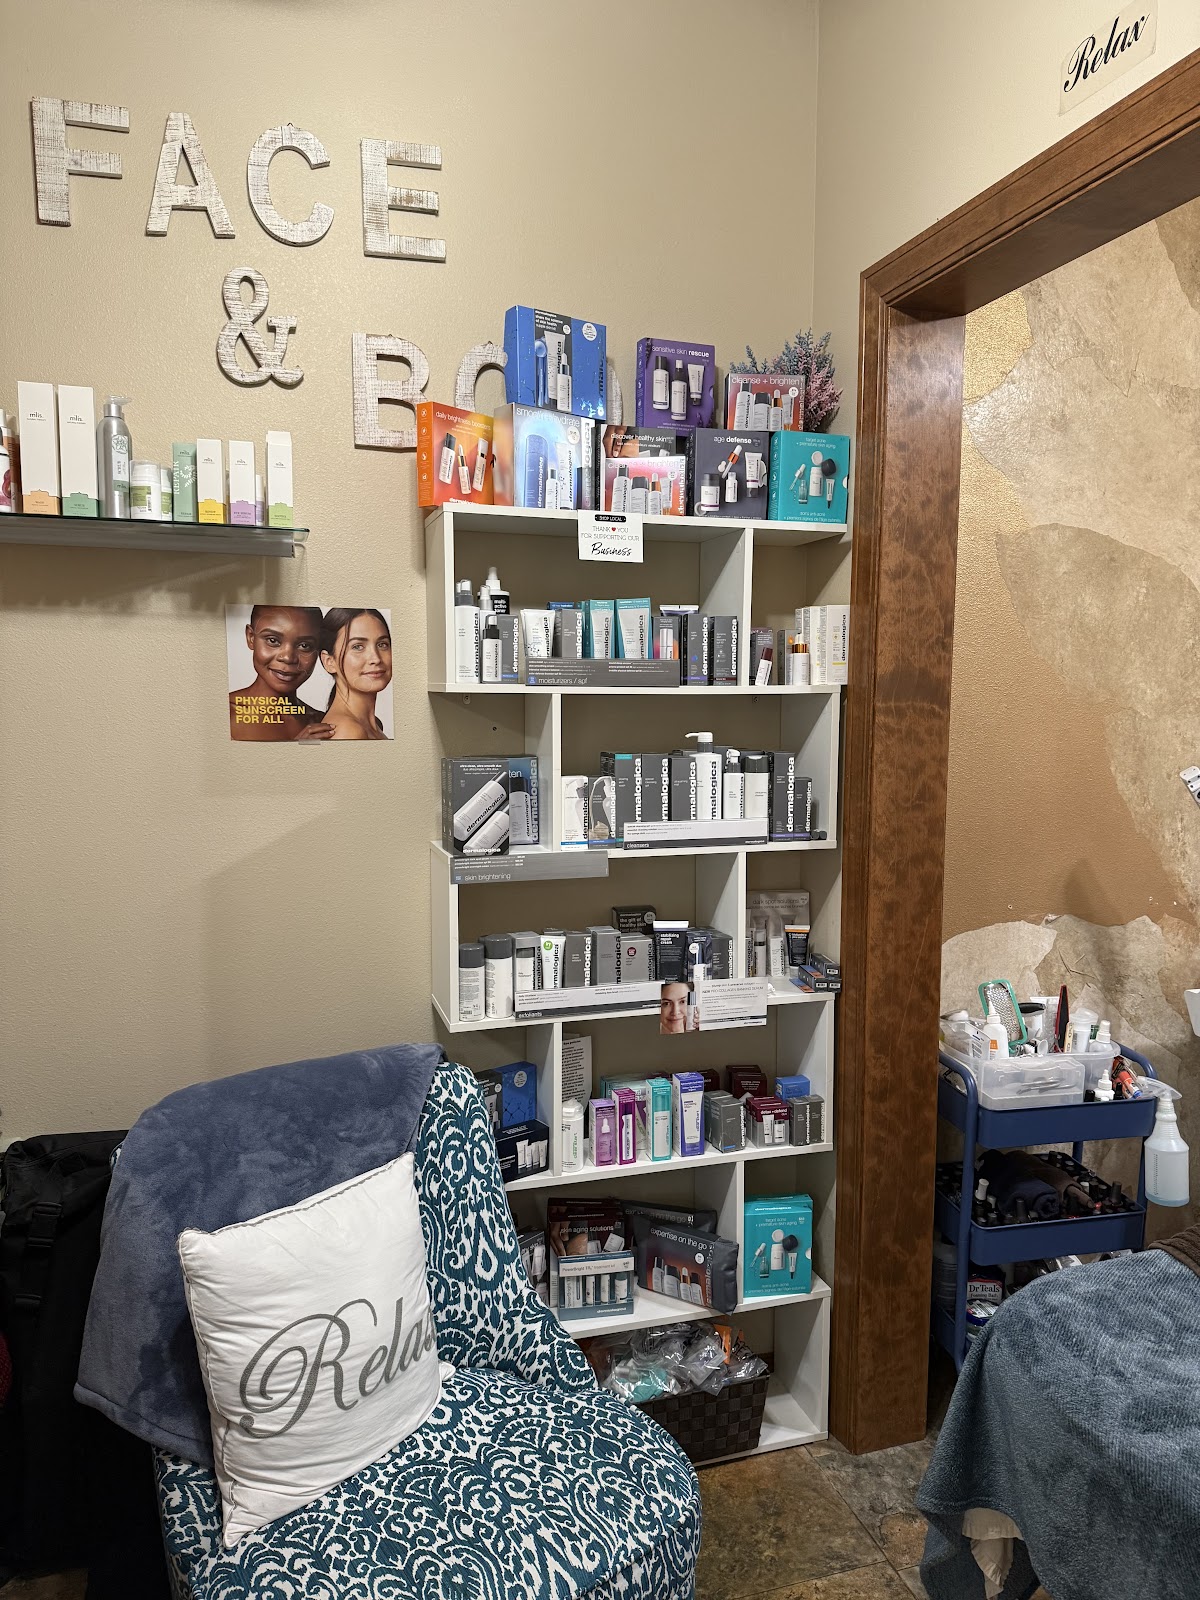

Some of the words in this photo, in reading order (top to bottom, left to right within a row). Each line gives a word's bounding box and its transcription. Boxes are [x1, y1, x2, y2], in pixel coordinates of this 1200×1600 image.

[1063, 13, 1150, 93] Relax
[30, 96, 447, 262] FACE
[216, 266, 305, 387] &
[652, 346, 676, 354] sensitive
[688, 350, 710, 358] rescue
[731, 376, 761, 385] cleanse
[769, 377, 800, 387] brighten
[435, 411, 447, 421] daily
[447, 414, 472, 427] brightness
[471, 420, 491, 431] boosters
[610, 433, 635, 441] discover
[635, 434, 655, 443] healthy
[713, 436, 725, 444] age
[725, 436, 752, 444] defense
[593, 533, 627, 541] SUPPORTING
[591, 541, 632, 557] Business
[577, 677, 588, 685] spf
[235, 696, 292, 706] PHYSICAL
[235, 705, 306, 715] SUNSCREEN
[235, 715, 260, 724] FOR
[262, 714, 284, 724] ALL
[530, 759, 538, 841] dermalogica
[786, 757, 794, 832] dermalogica
[466, 793, 505, 833] dermalogica
[464, 873, 478, 881] skin
[478, 872, 511, 882] brightening
[572, 1226, 588, 1234] aging
[650, 1228, 678, 1242] expertise
[688, 1238, 698, 1247] the
[698, 1242, 708, 1251] go
[969, 1284, 980, 1293] Dr
